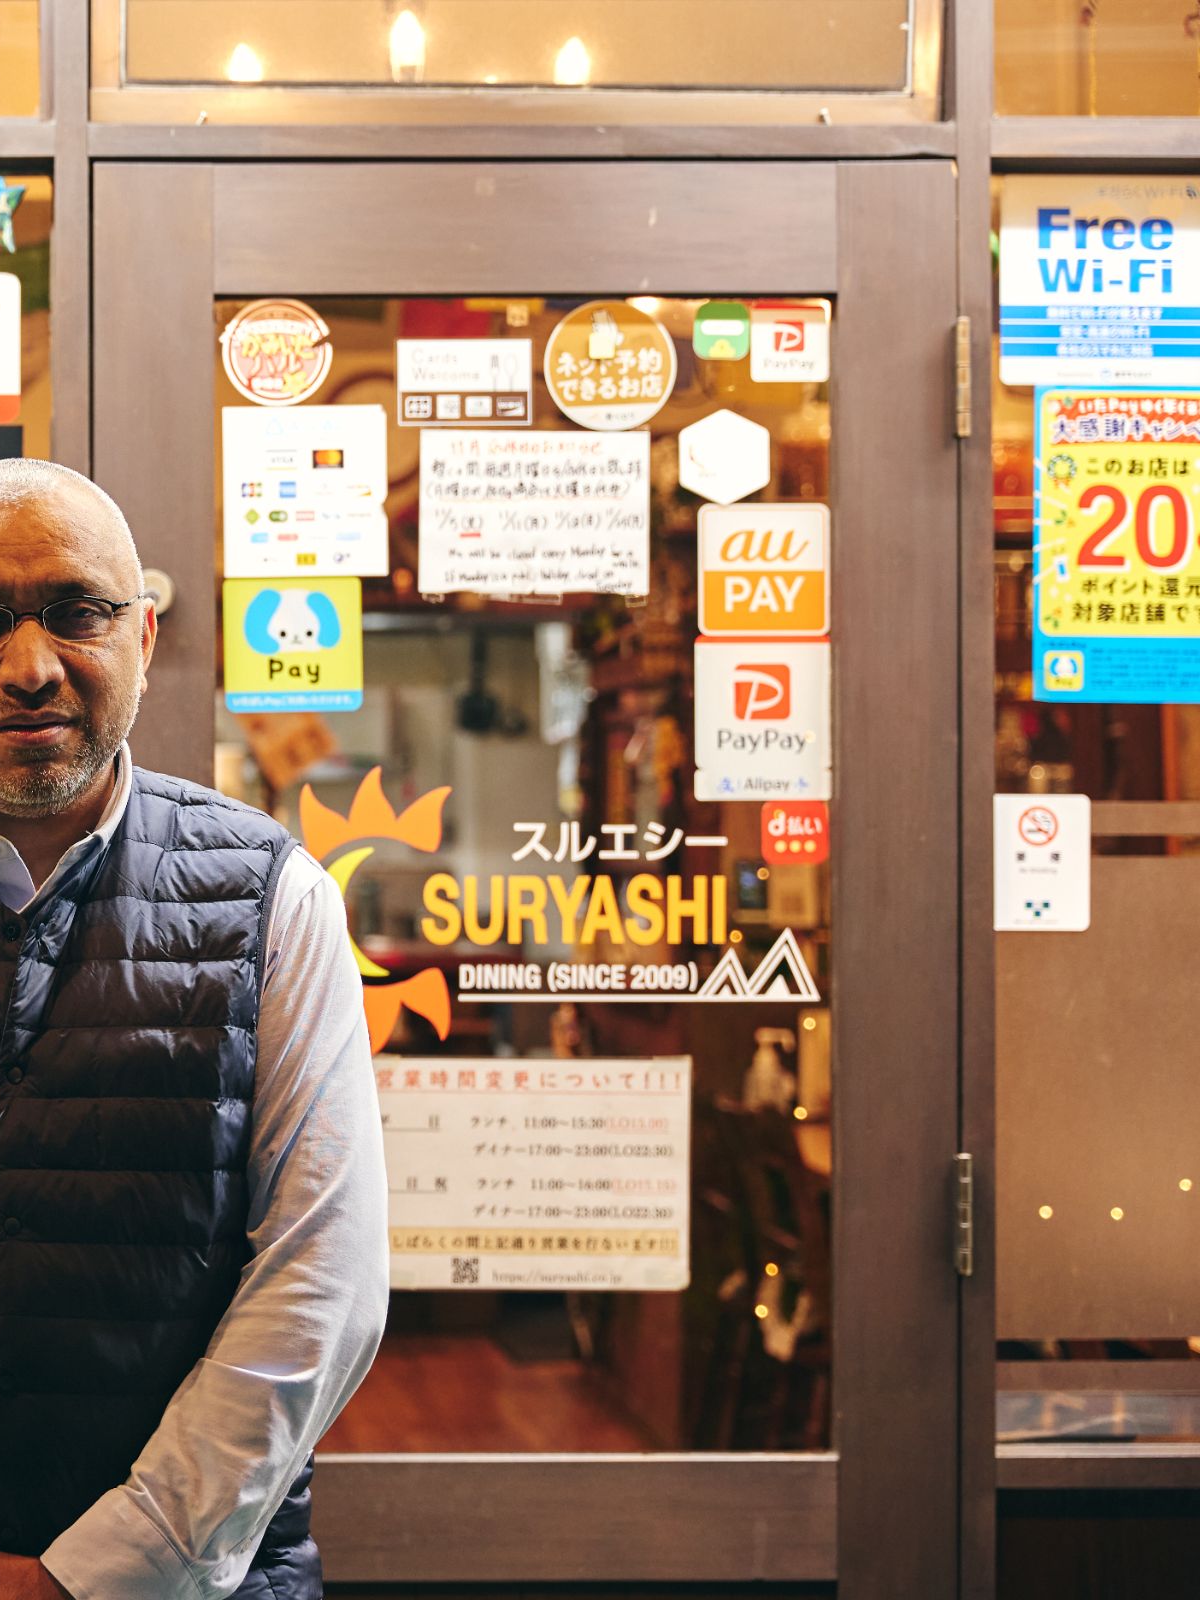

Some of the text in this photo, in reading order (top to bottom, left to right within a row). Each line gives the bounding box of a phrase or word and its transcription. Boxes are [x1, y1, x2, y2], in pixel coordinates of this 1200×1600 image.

[1037, 208, 1174, 250] Free
[1038, 258, 1173, 293] Wi-Fi
[411, 347, 458, 365] Cards
[556, 347, 663, 377] ネット予約
[411, 367, 481, 382] Welcome
[556, 374, 663, 401] できるお店
[1085, 458, 1190, 478] このお店は
[1076, 484, 1200, 568] 20
[719, 528, 810, 563] au
[724, 576, 805, 612] PAY
[1072, 602, 1200, 624] 対象店舗で
[268, 658, 320, 684] Pay
[716, 728, 807, 754] PayPay
[743, 776, 790, 793] Alipay
[768, 812, 823, 837] d払い
[511, 820, 728, 864] スルエシー
[421, 873, 727, 946] SURYASHI
[458, 963, 699, 993] DINING (SINCE 2009)
